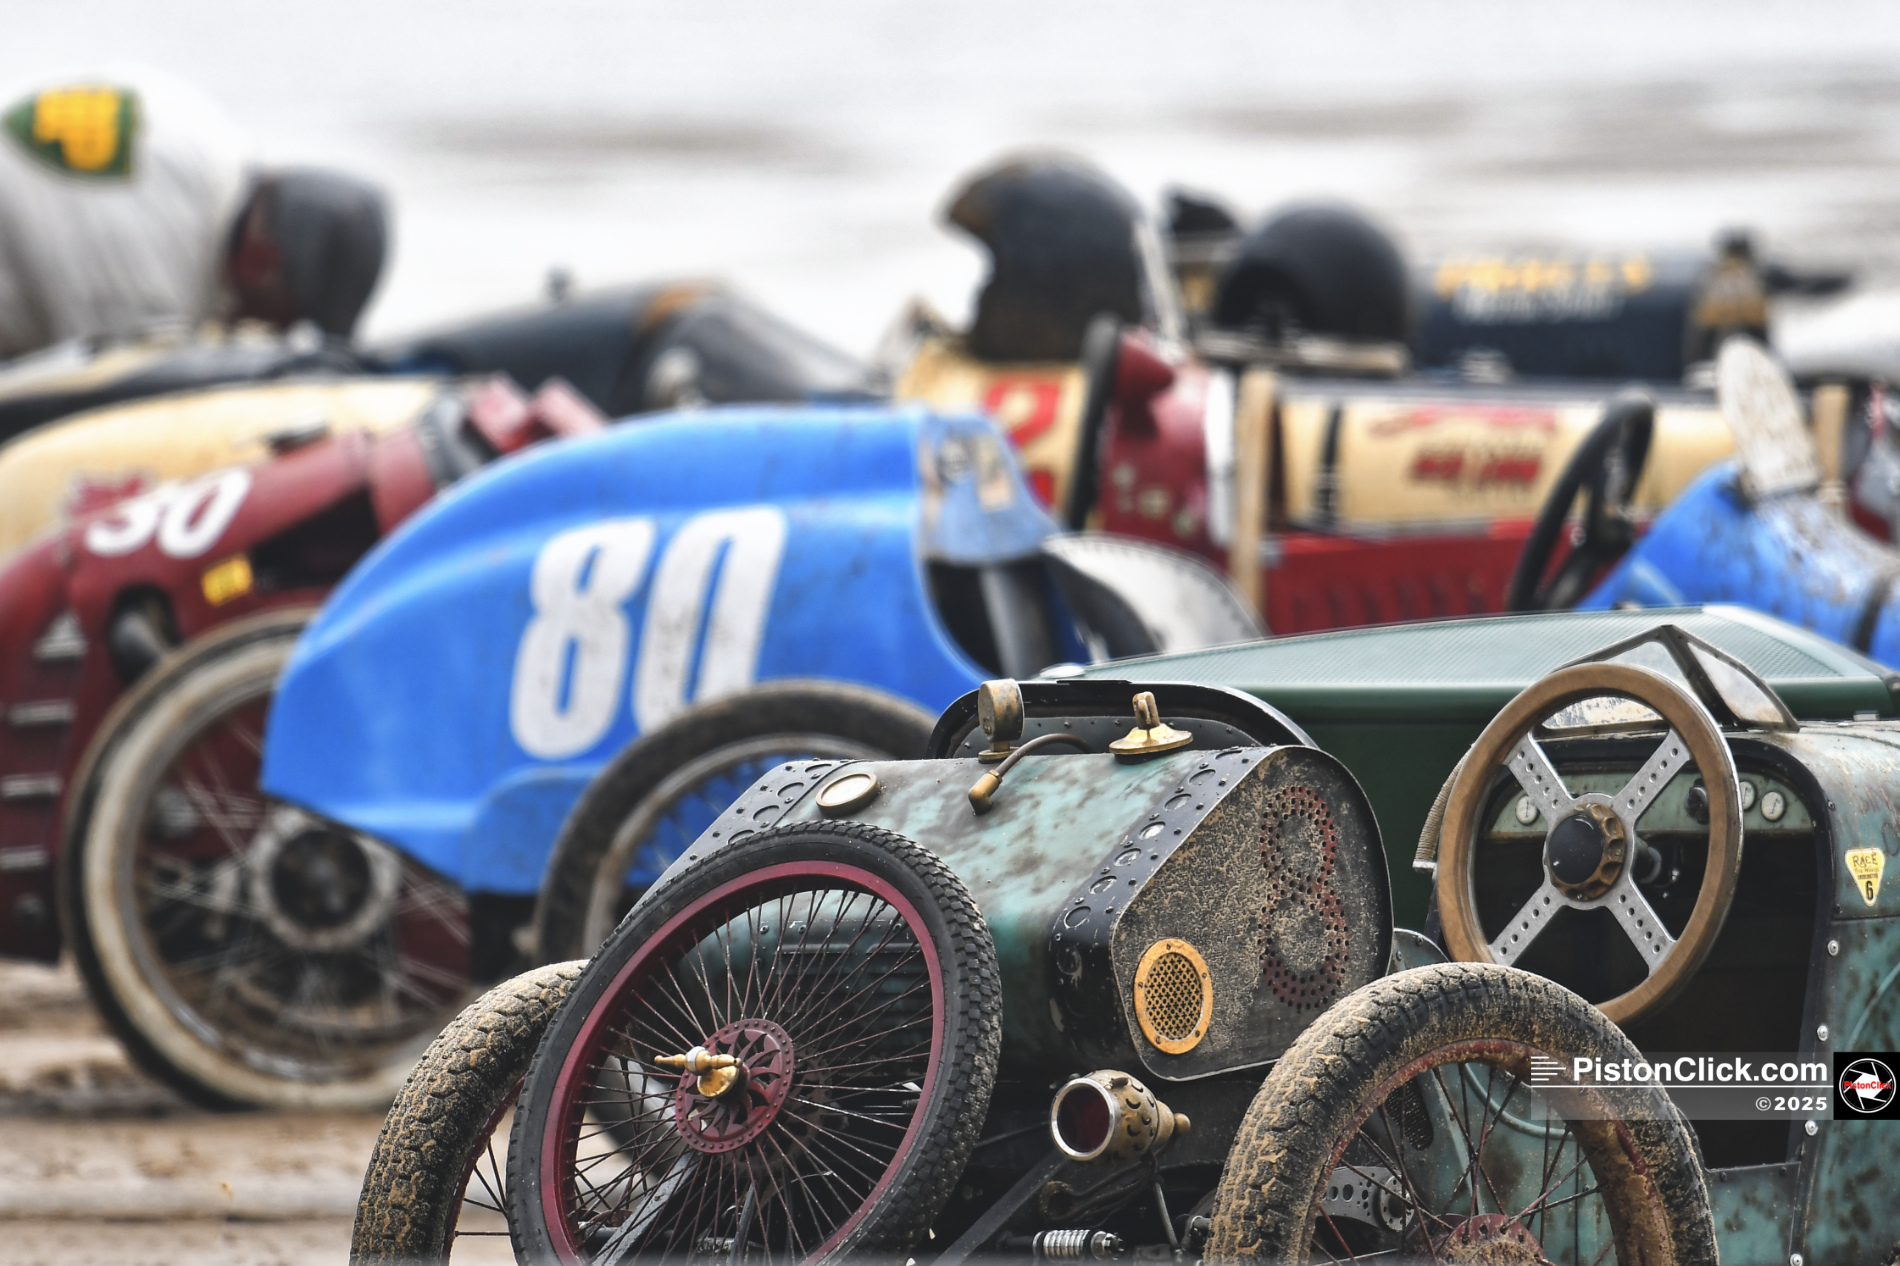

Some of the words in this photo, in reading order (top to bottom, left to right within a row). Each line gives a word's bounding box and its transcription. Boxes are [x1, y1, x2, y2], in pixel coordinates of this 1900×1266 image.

[509, 504, 788, 759] 80
[1852, 852, 1878, 868] RACE
[1866, 880, 1874, 901] 6
